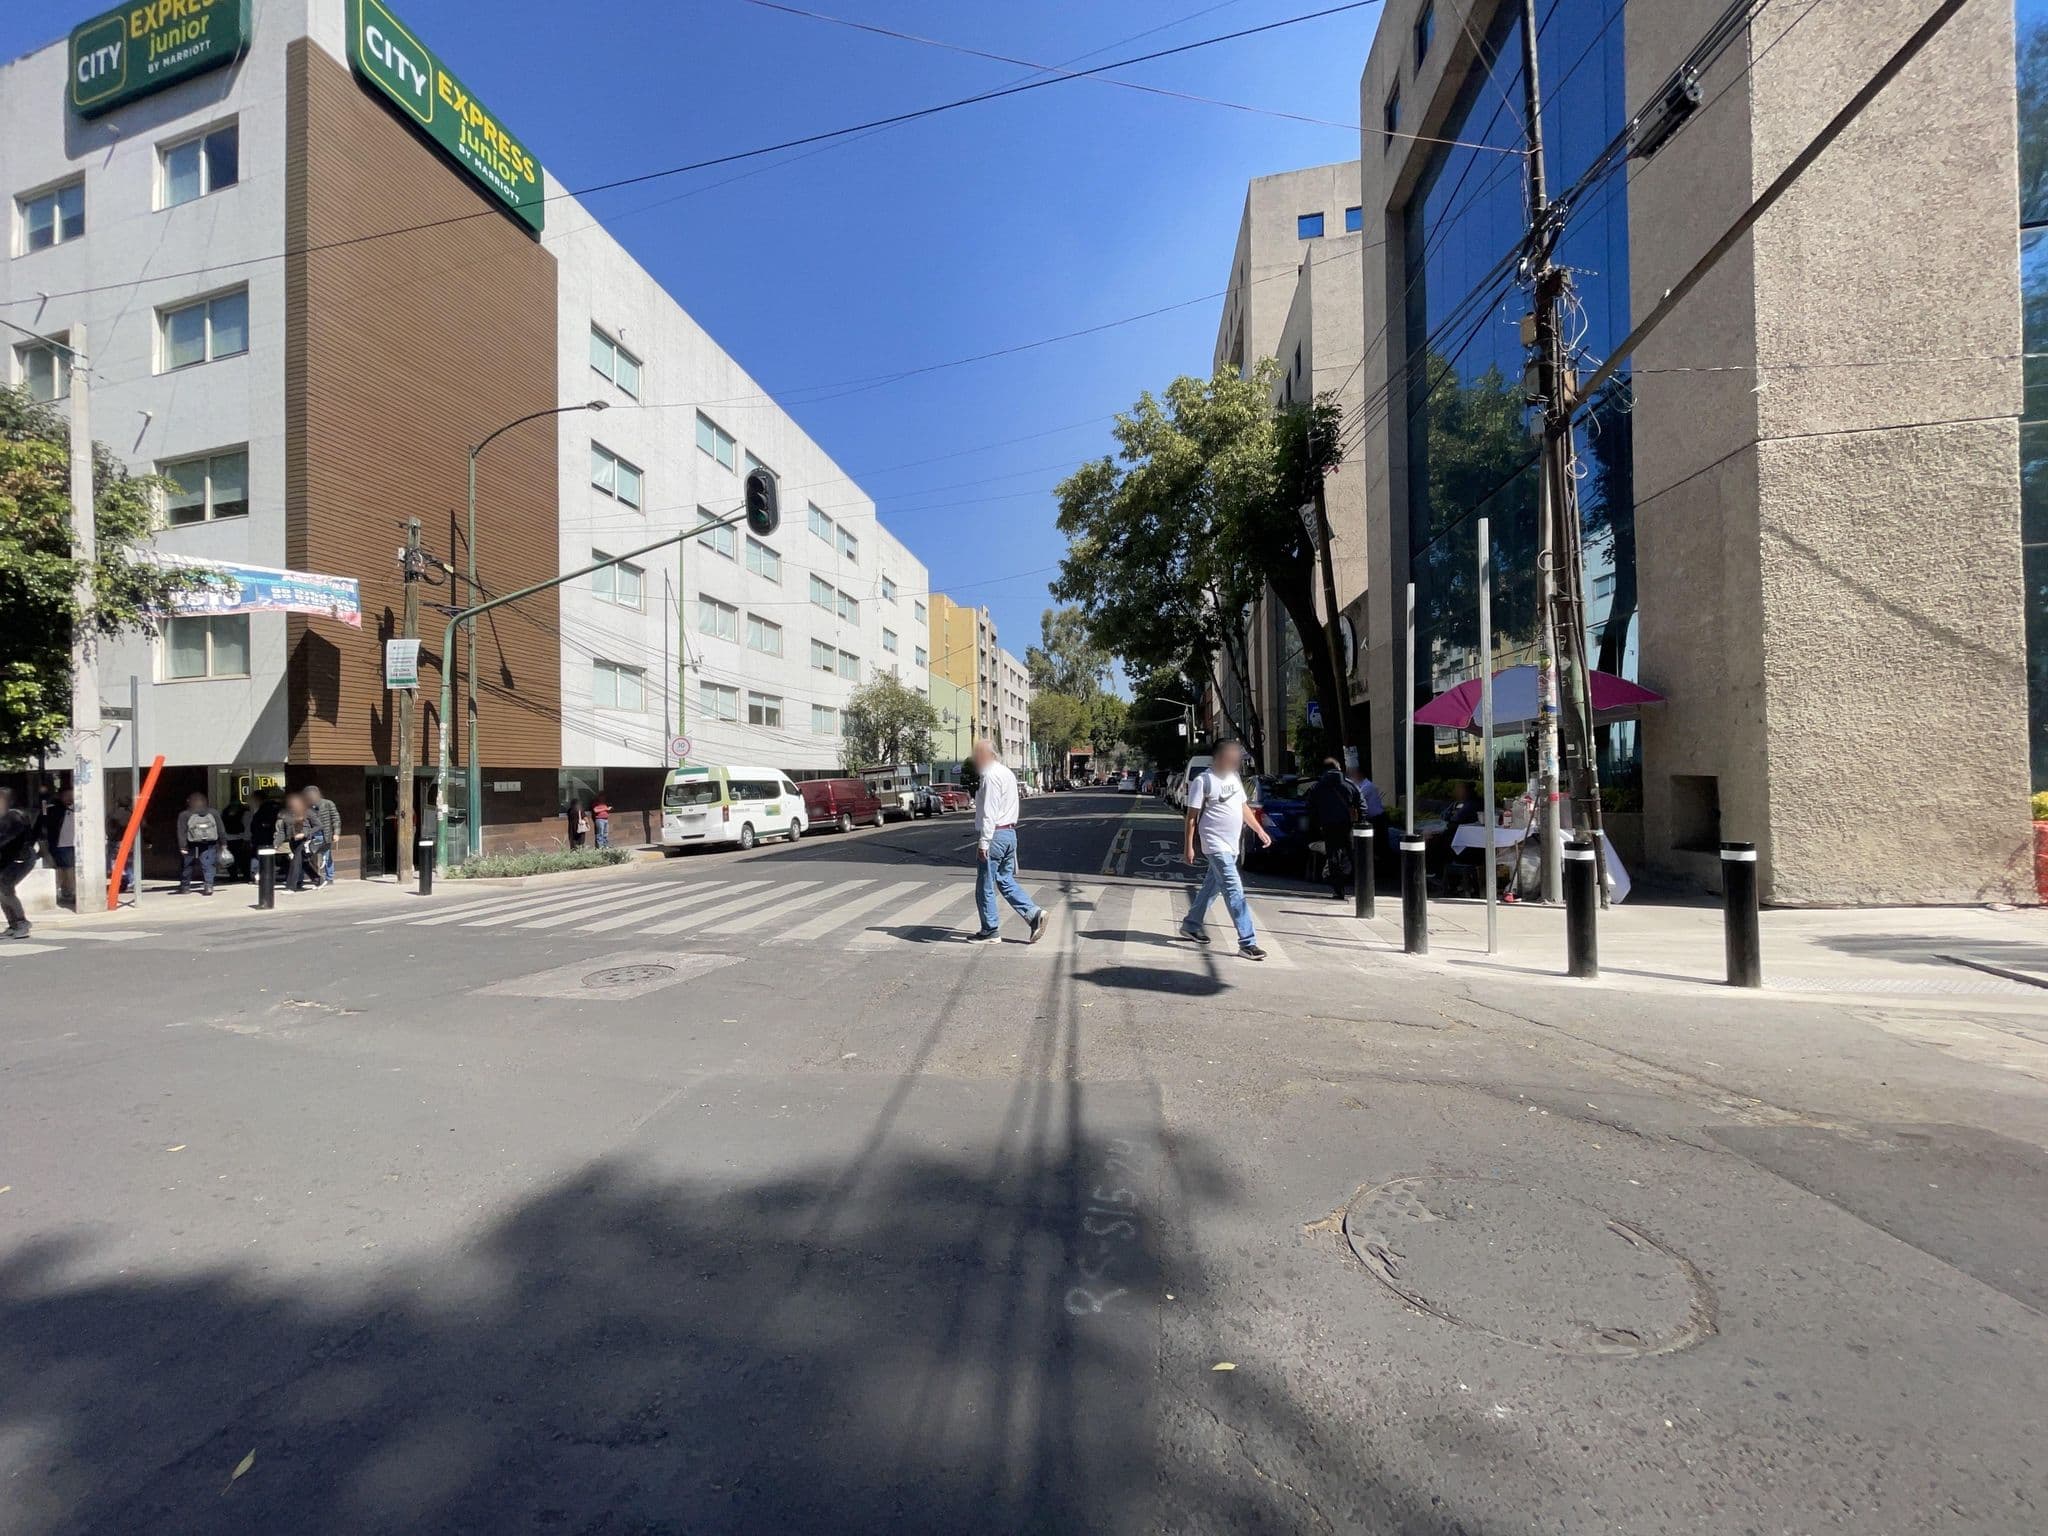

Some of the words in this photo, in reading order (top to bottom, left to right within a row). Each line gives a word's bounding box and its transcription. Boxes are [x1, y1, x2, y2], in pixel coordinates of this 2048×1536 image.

[77, 42, 122, 83] CITY
[147, 62, 160, 74] BY
[162, 40, 211, 67] MARRIOTT
[149, 14, 210, 61] junior
[366, 25, 427, 97] CITY
[438, 70, 535, 184] EXPRESS
[459, 118, 518, 187] junior
[459, 143, 471, 159] BY
[474, 158, 520, 204] MARRIOTT
